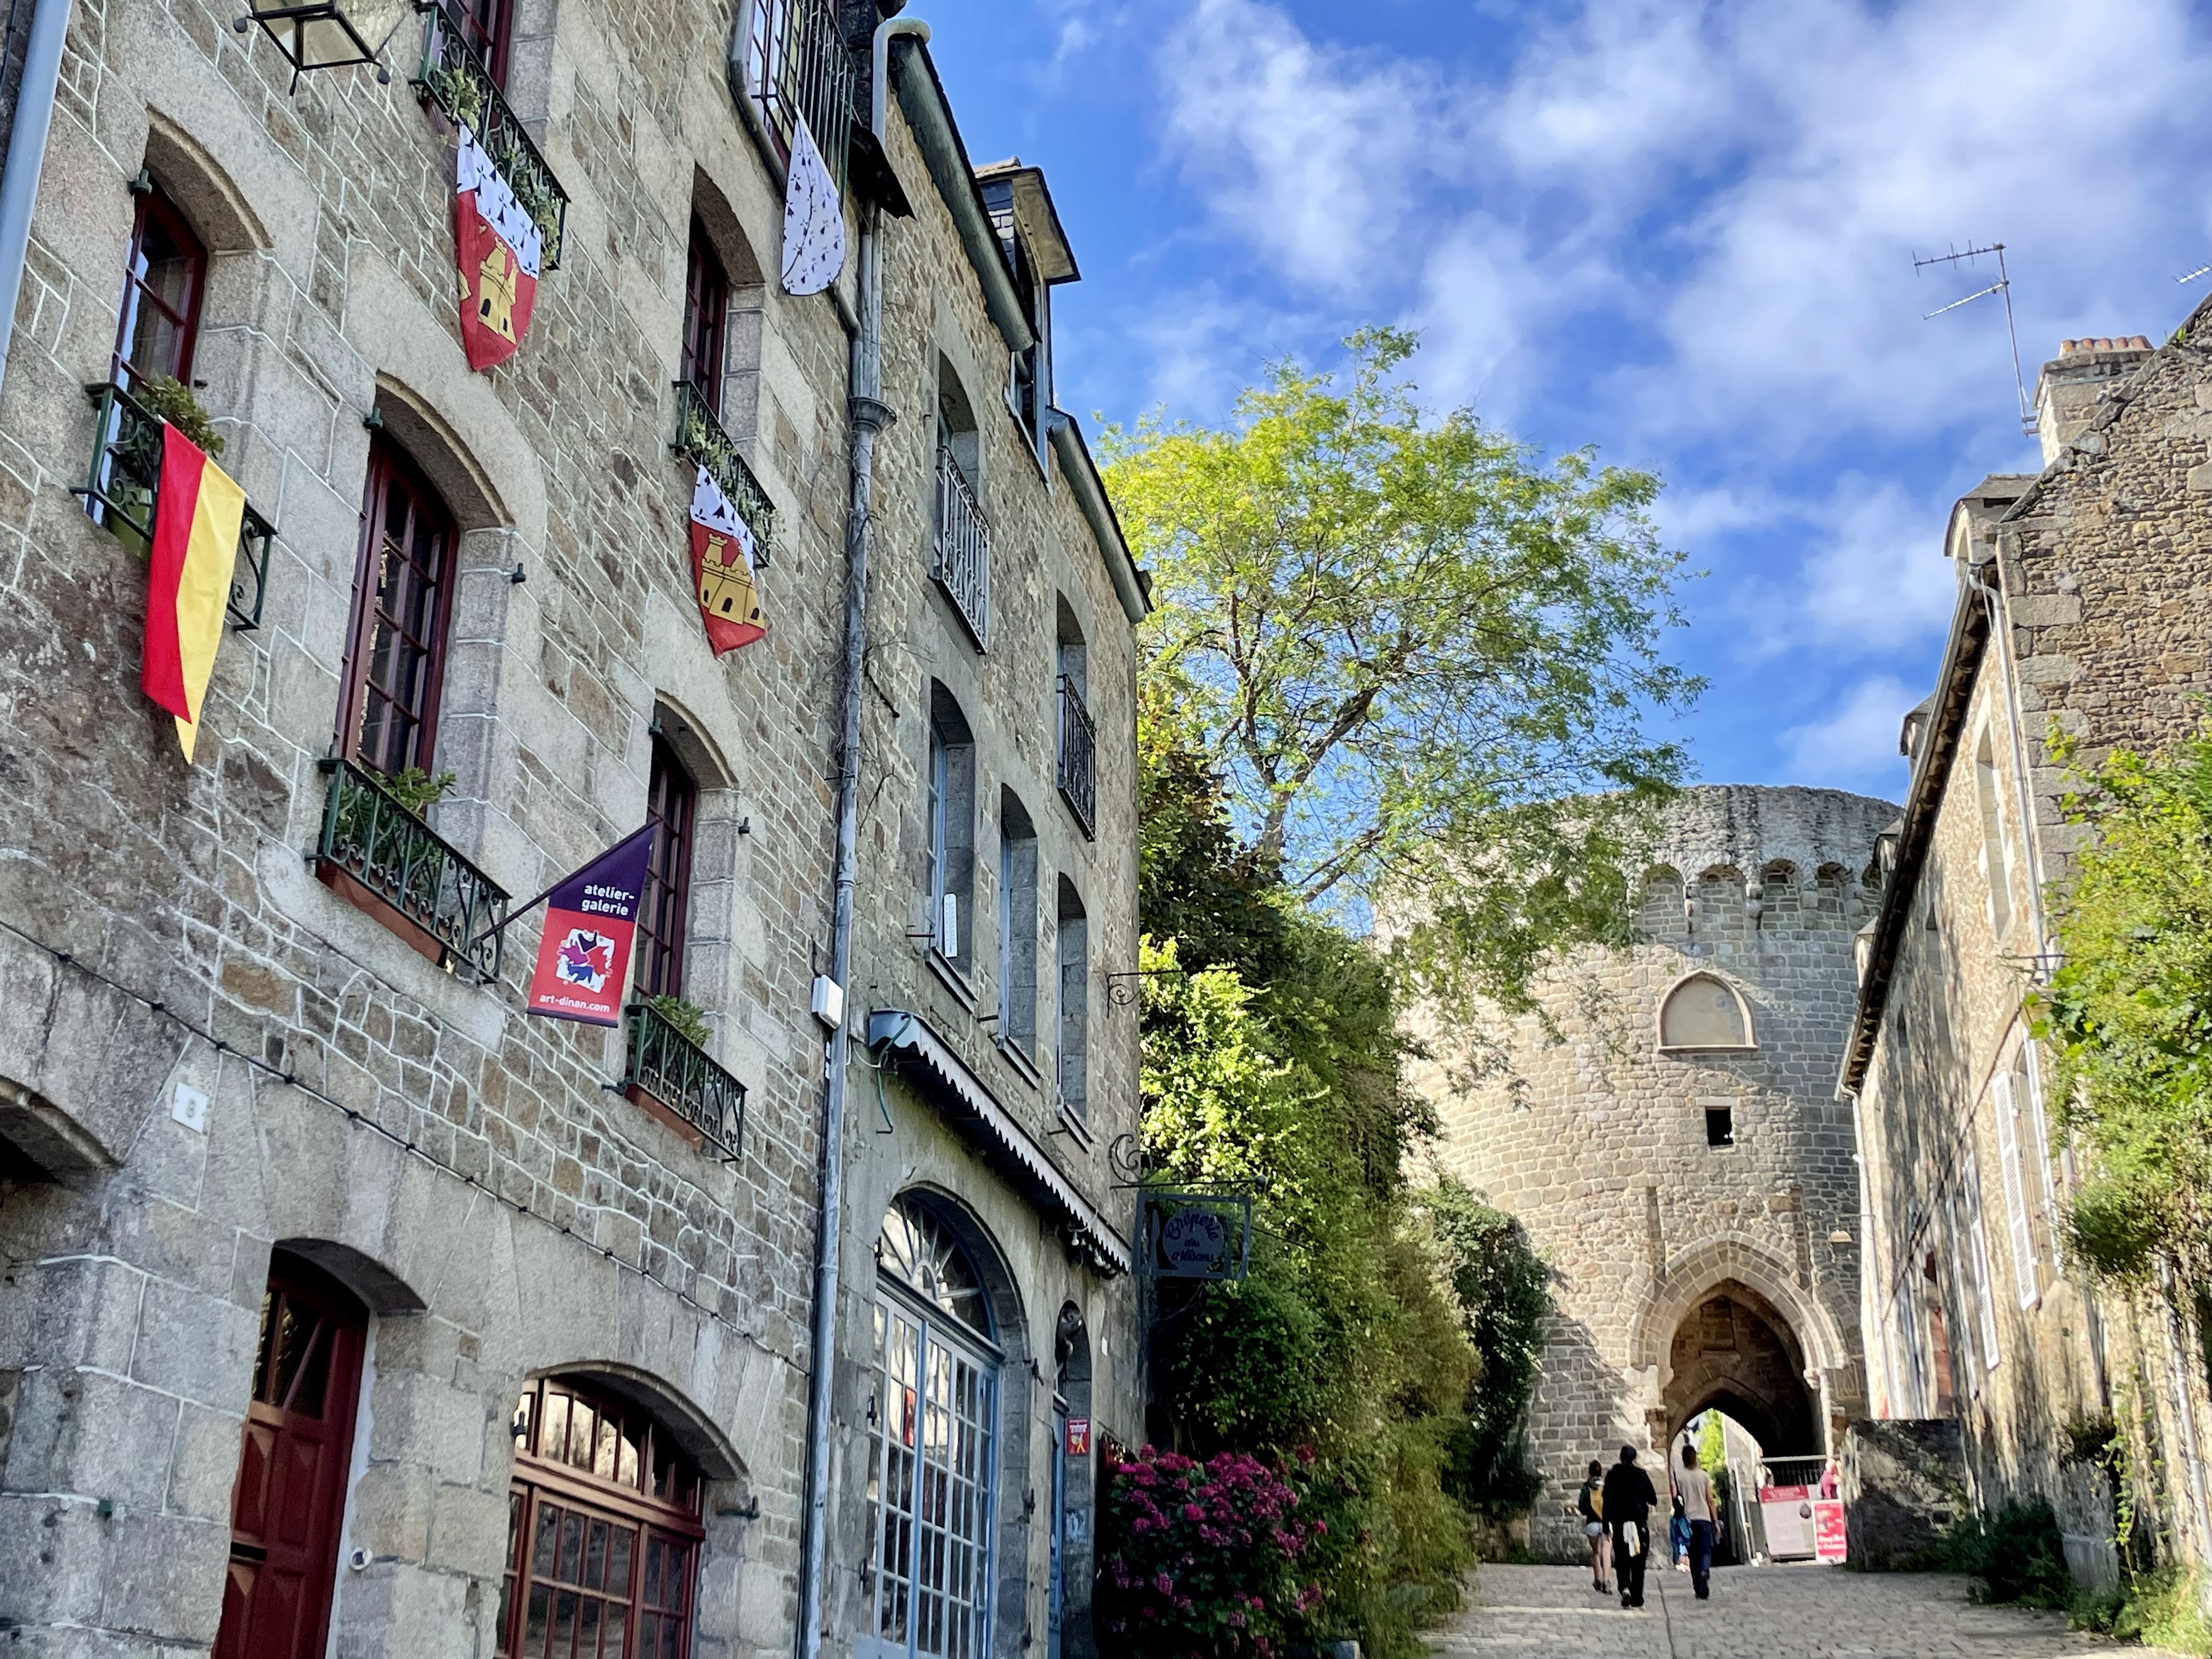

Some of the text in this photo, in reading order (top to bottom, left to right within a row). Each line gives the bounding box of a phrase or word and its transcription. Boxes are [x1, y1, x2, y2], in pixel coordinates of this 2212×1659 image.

[584, 884, 635, 901] atelier-
[582, 899, 629, 916] galerie
[539, 994, 610, 1013] art-dinan.com
[186, 1098, 196, 1119] 8
